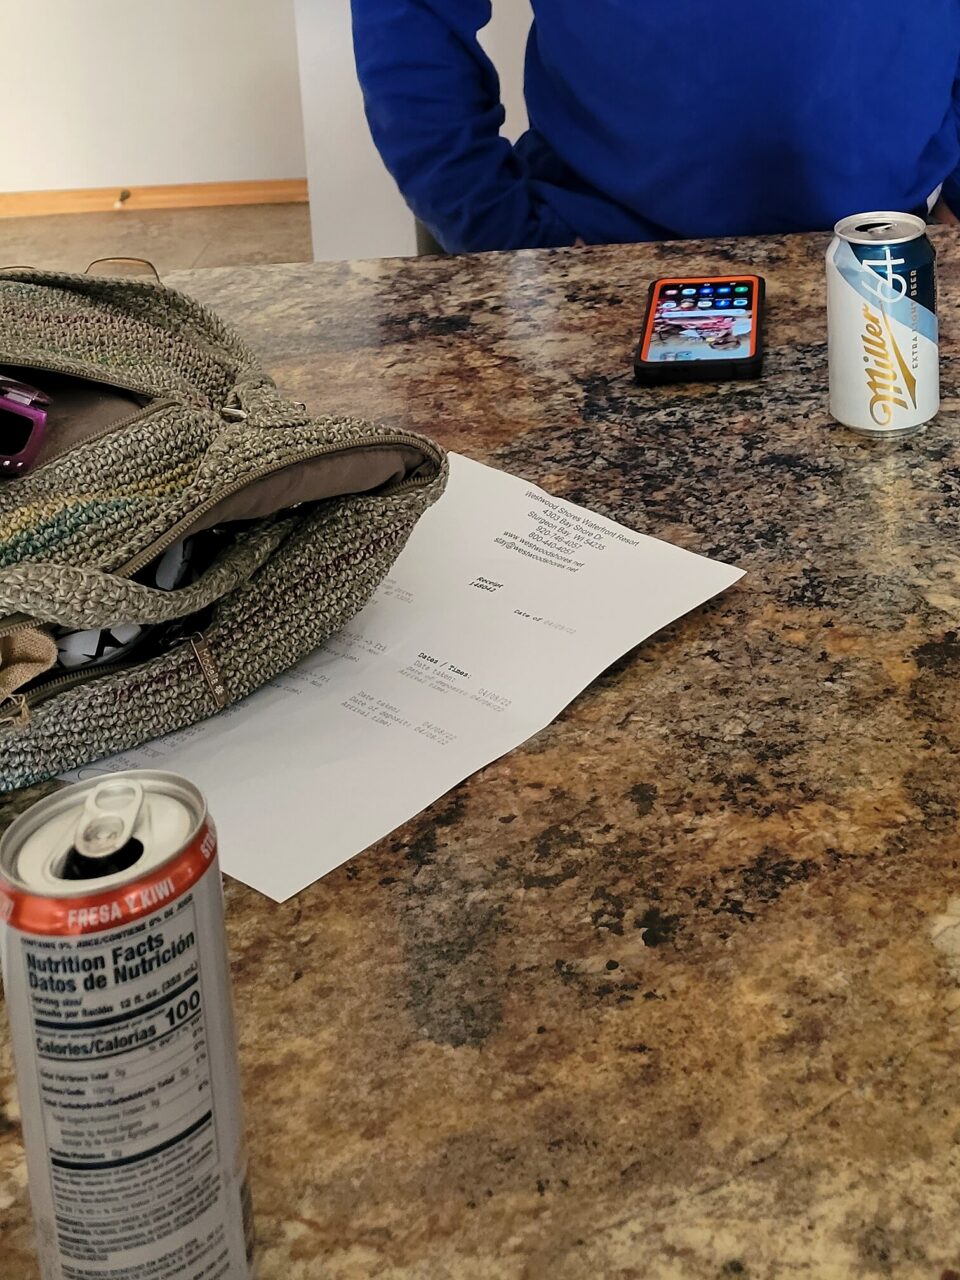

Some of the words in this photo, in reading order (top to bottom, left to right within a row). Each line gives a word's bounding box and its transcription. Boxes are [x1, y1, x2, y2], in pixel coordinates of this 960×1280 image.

[862, 249, 906, 302] 64
[861, 304, 908, 426] Miller
[525, 490, 559, 510] Westwood
[559, 506, 582, 522] Shores
[582, 517, 617, 538] Waterfront
[616, 534, 640, 547] Resort
[527, 510, 557, 530] Sturgeon
[542, 508, 560, 521] 4303
[559, 518, 573, 528] Bay
[573, 524, 593, 537] Shore
[476, 576, 503, 588] Receipt
[513, 609, 530, 618] Date
[418, 652, 438, 664] Dates
[448, 664, 472, 679] Times:
[67, 901, 122, 929] FRESA
[123, 892, 139, 913] Y
[138, 879, 176, 907] KIWI
[27, 951, 106, 974] Nutrition
[111, 932, 165, 966] Facts
[29, 972, 77, 994] Datos
[83, 972, 107, 991] de
[114, 931, 196, 985] Nutrición
[165, 989, 202, 1026] 100
